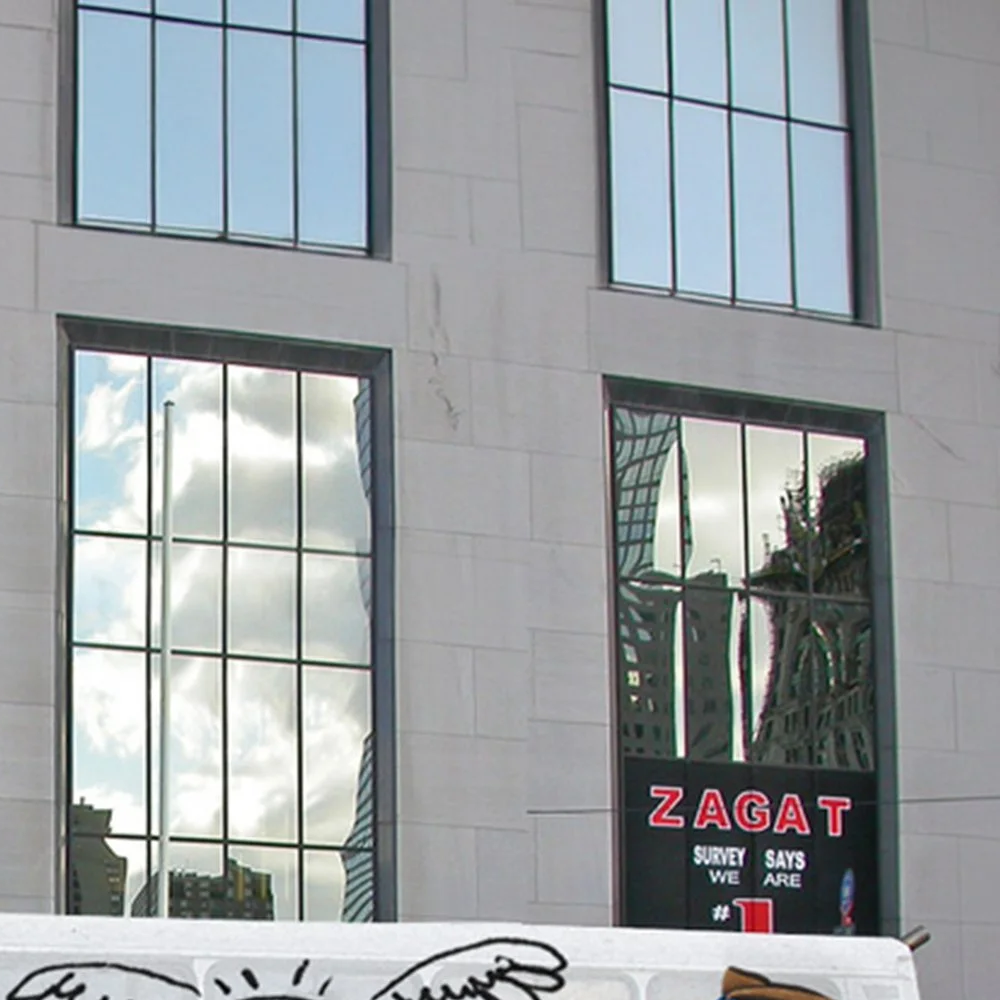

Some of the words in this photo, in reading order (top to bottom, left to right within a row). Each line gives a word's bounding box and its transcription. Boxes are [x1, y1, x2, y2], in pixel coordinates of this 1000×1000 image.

[649, 786, 852, 837] ZAGAT
[693, 844, 746, 866] SURVEY
[764, 849, 807, 870] SAYS
[708, 869, 740, 884] WE
[763, 872, 802, 888] ARE
